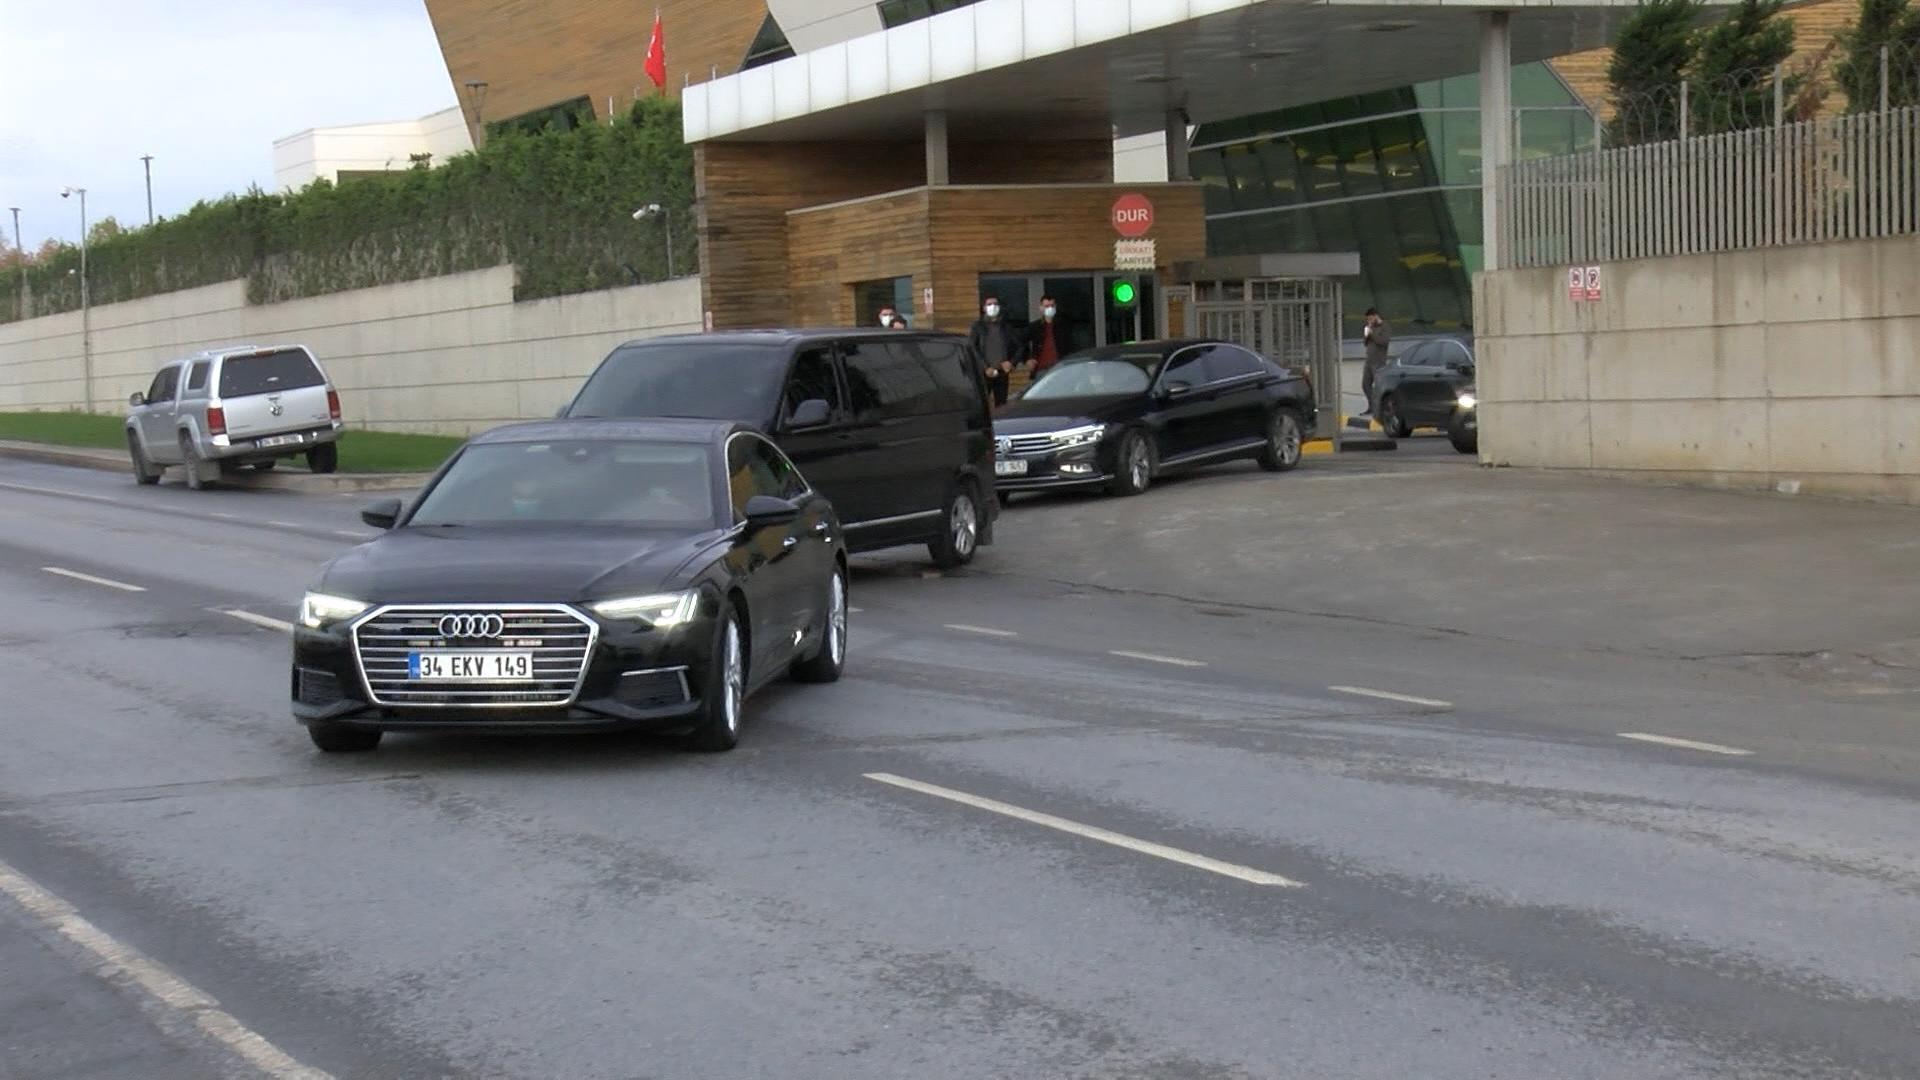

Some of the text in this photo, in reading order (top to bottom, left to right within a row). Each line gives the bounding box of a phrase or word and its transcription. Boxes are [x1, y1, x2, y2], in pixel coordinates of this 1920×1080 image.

[1117, 208, 1148, 222] DUR
[421, 656, 527, 676] 34 EKV 149
